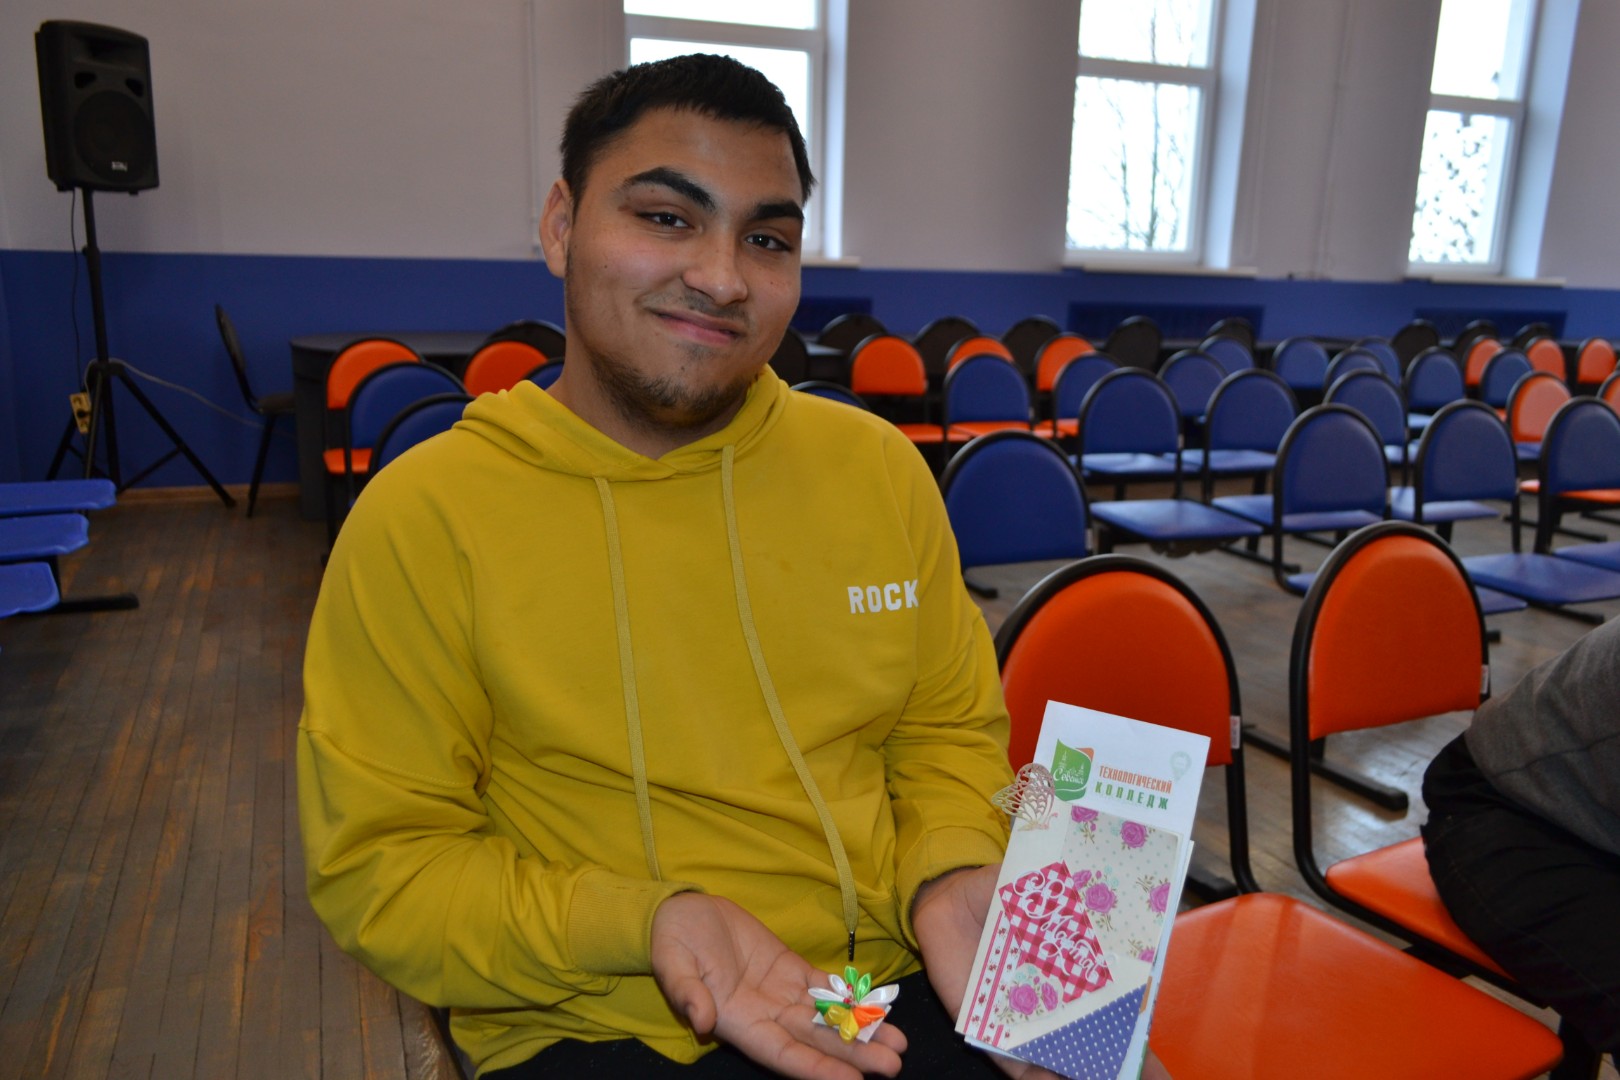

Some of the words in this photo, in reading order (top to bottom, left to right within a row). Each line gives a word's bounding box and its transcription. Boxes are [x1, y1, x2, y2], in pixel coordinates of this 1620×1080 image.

[847, 579, 918, 614] ROCK
[1099, 765, 1173, 794] ТЕХНОЛОГИЧЕСКИЙ
[1095, 782, 1169, 810] КОЛЛЕДЖ
